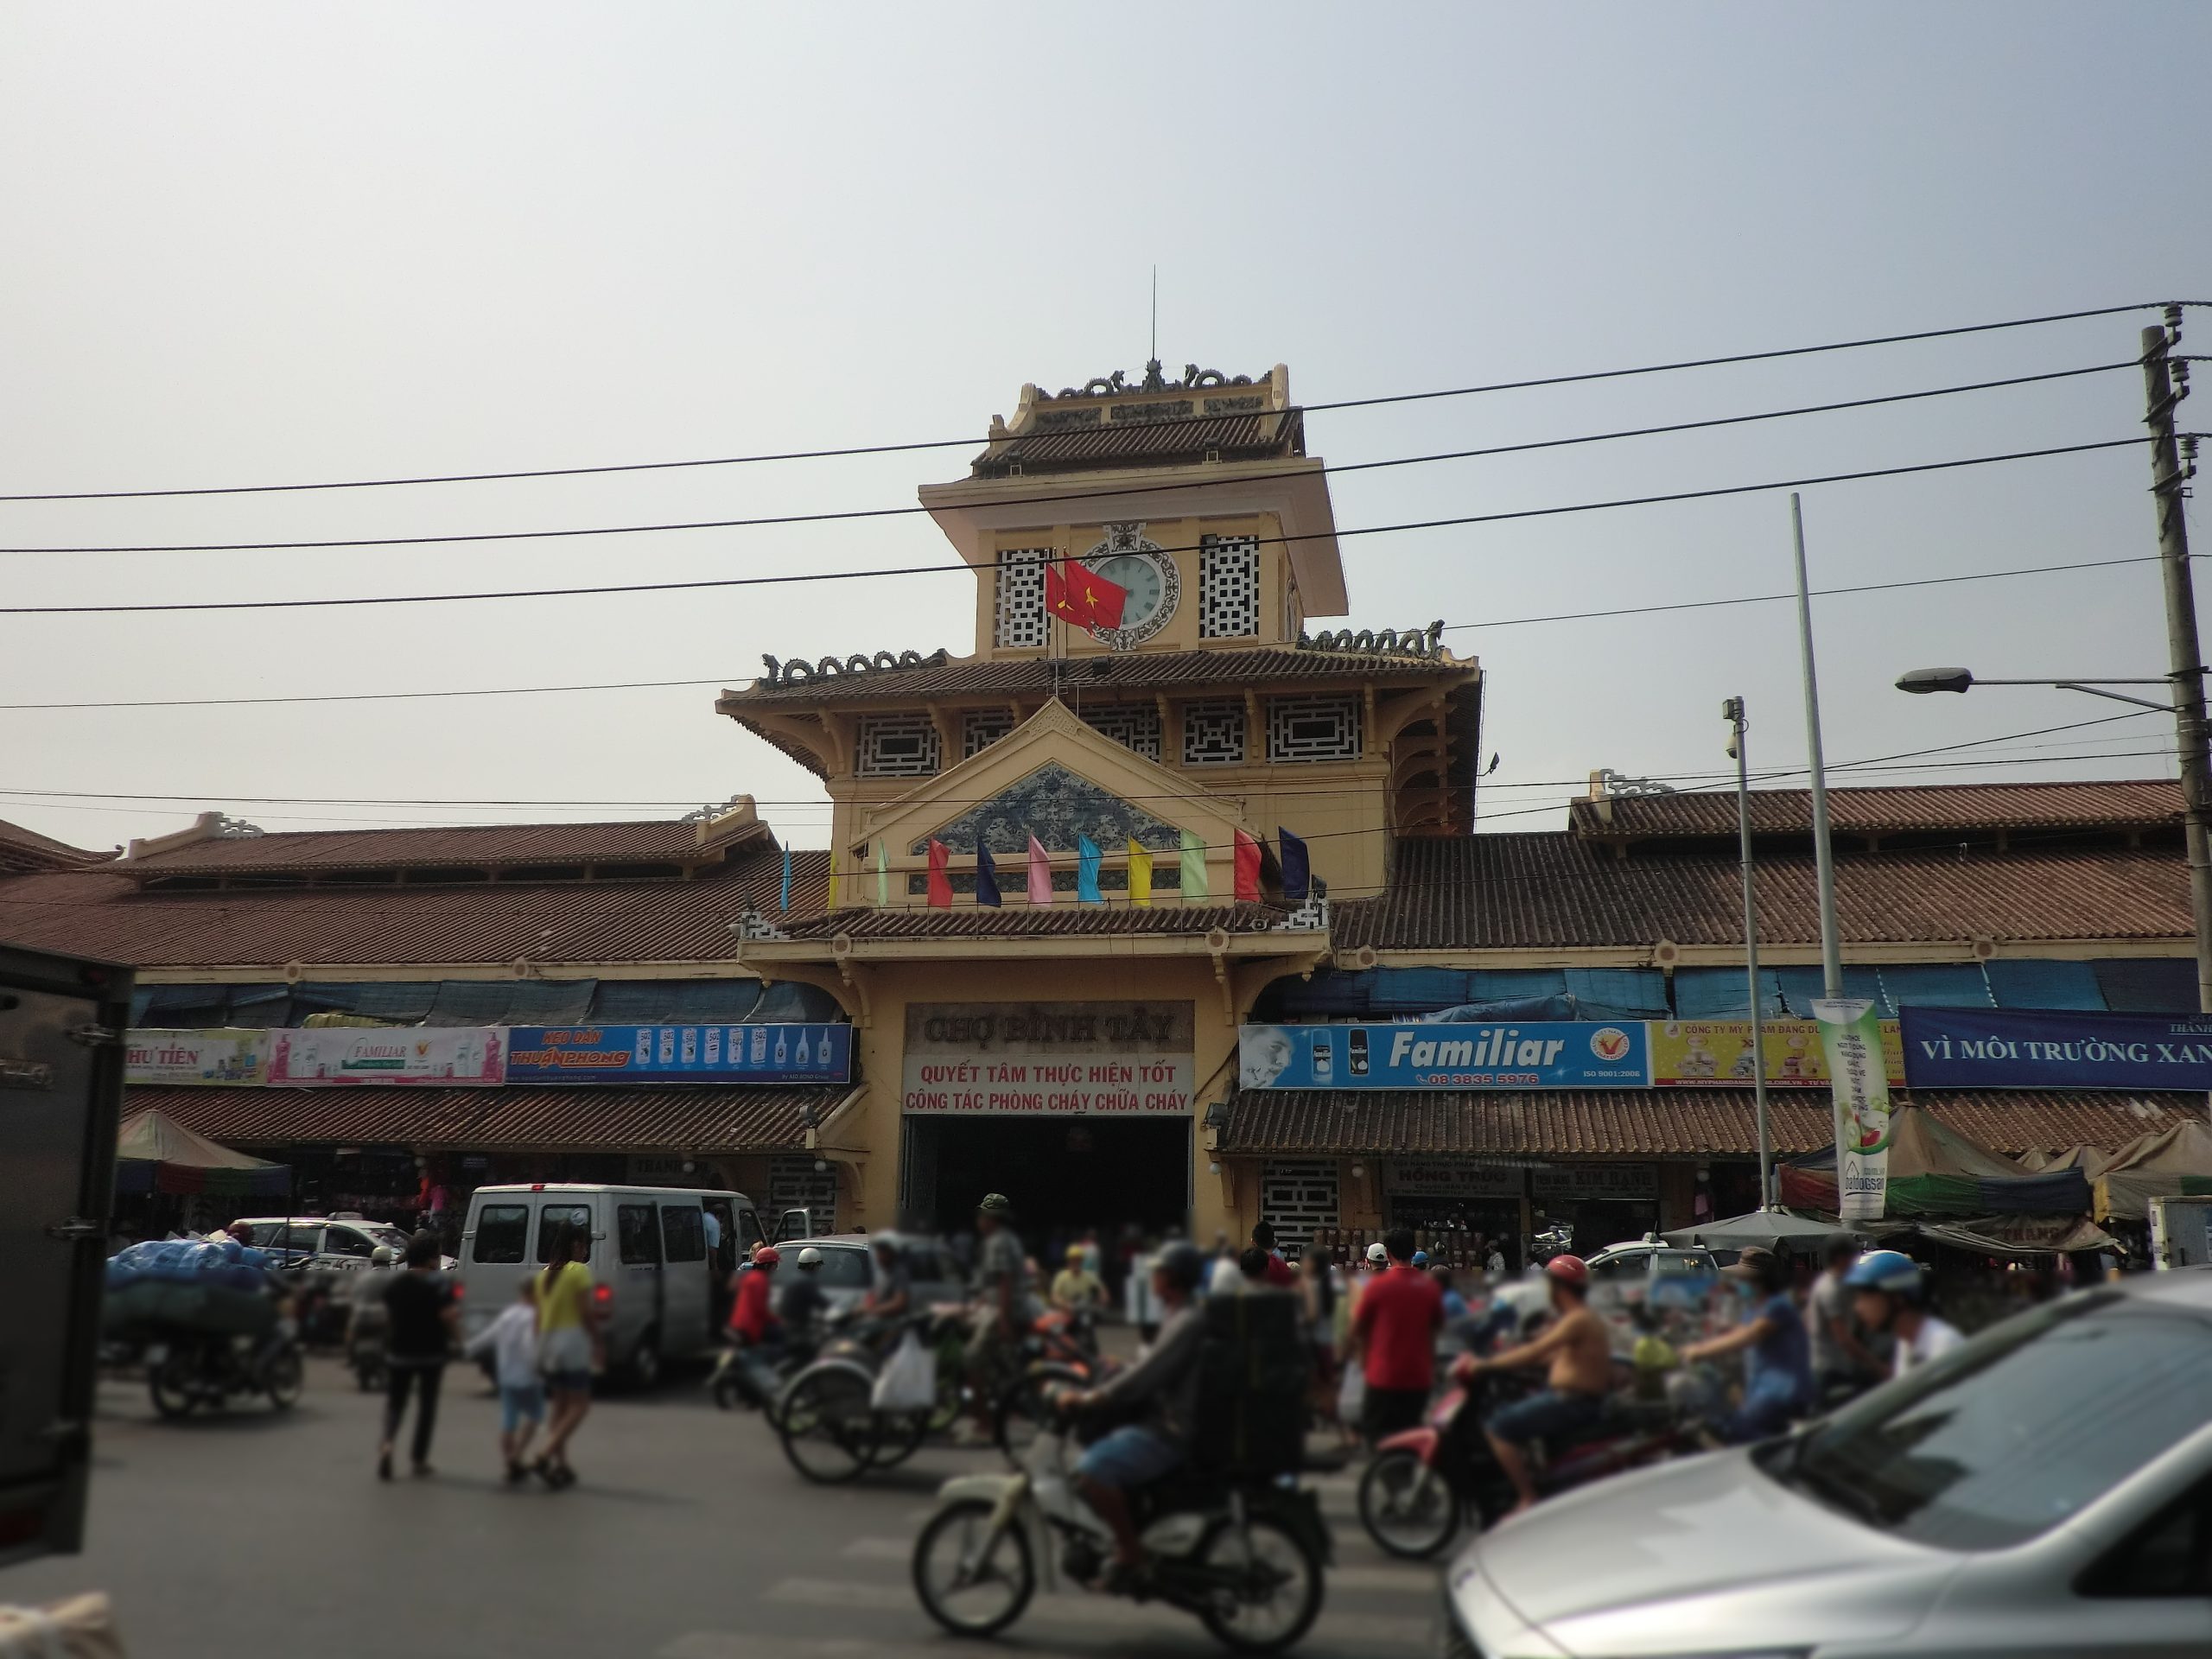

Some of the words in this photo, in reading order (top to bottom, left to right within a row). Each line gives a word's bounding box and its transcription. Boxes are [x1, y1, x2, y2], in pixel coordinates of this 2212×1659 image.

[924, 1014, 995, 1050] CHỢ
[1714, 1026, 1726, 1034] TY
[353, 1045, 406, 1058] FAMILIAR
[1389, 1028, 1565, 1068] Familiar
[1921, 1034, 1954, 1059] VÌ
[1961, 1034, 2020, 1060] MÔI
[2024, 1037, 2150, 1063] TRƯỜNG
[920, 1059, 980, 1085] QUYẾT
[986, 1062, 1027, 1083] TÂM
[1033, 1063, 1083, 1087] THỰC
[1089, 1061, 1133, 1087] HIỆN
[1140, 1059, 1176, 1083] TỐT
[1428, 1073, 1449, 1084] 08
[1453, 1073, 1493, 1084] 3835
[1497, 1073, 1539, 1084] 5976
[906, 1088, 948, 1110] CÔNG
[953, 1089, 984, 1110] TÁC
[988, 1089, 1043, 1110] PHÒNG
[1048, 1089, 1091, 1110] CHÁY
[1095, 1087, 1139, 1110] CHỮA
[1145, 1089, 1188, 1110] CHÁY
